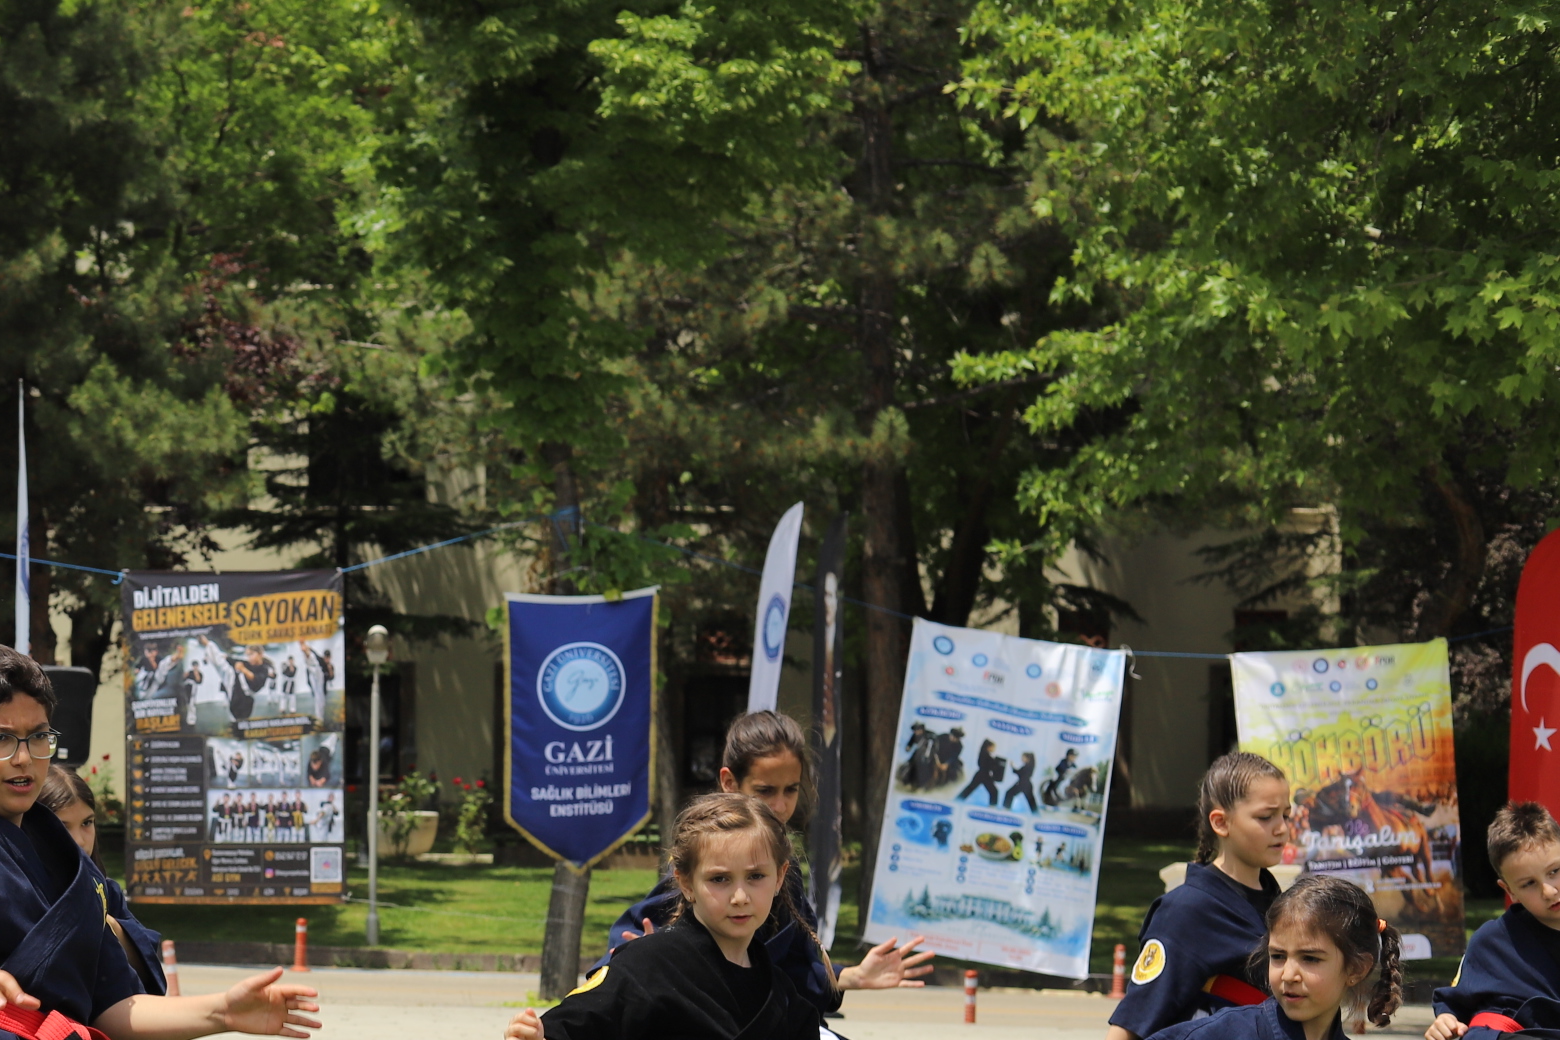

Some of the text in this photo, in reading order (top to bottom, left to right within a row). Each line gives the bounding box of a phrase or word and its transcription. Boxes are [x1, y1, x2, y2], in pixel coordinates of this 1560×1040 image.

[133, 583, 220, 609] DİJİTALDEN
[132, 602, 228, 632] GELENEKSELE
[235, 595, 335, 628] SAYOKAN
[238, 627, 262, 641] TÜRK
[544, 734, 613, 764] GAZİ
[531, 782, 631, 801] SAĞLIK BİLİMLERİ
[550, 798, 613, 818] ENSTİTÜSÜ
